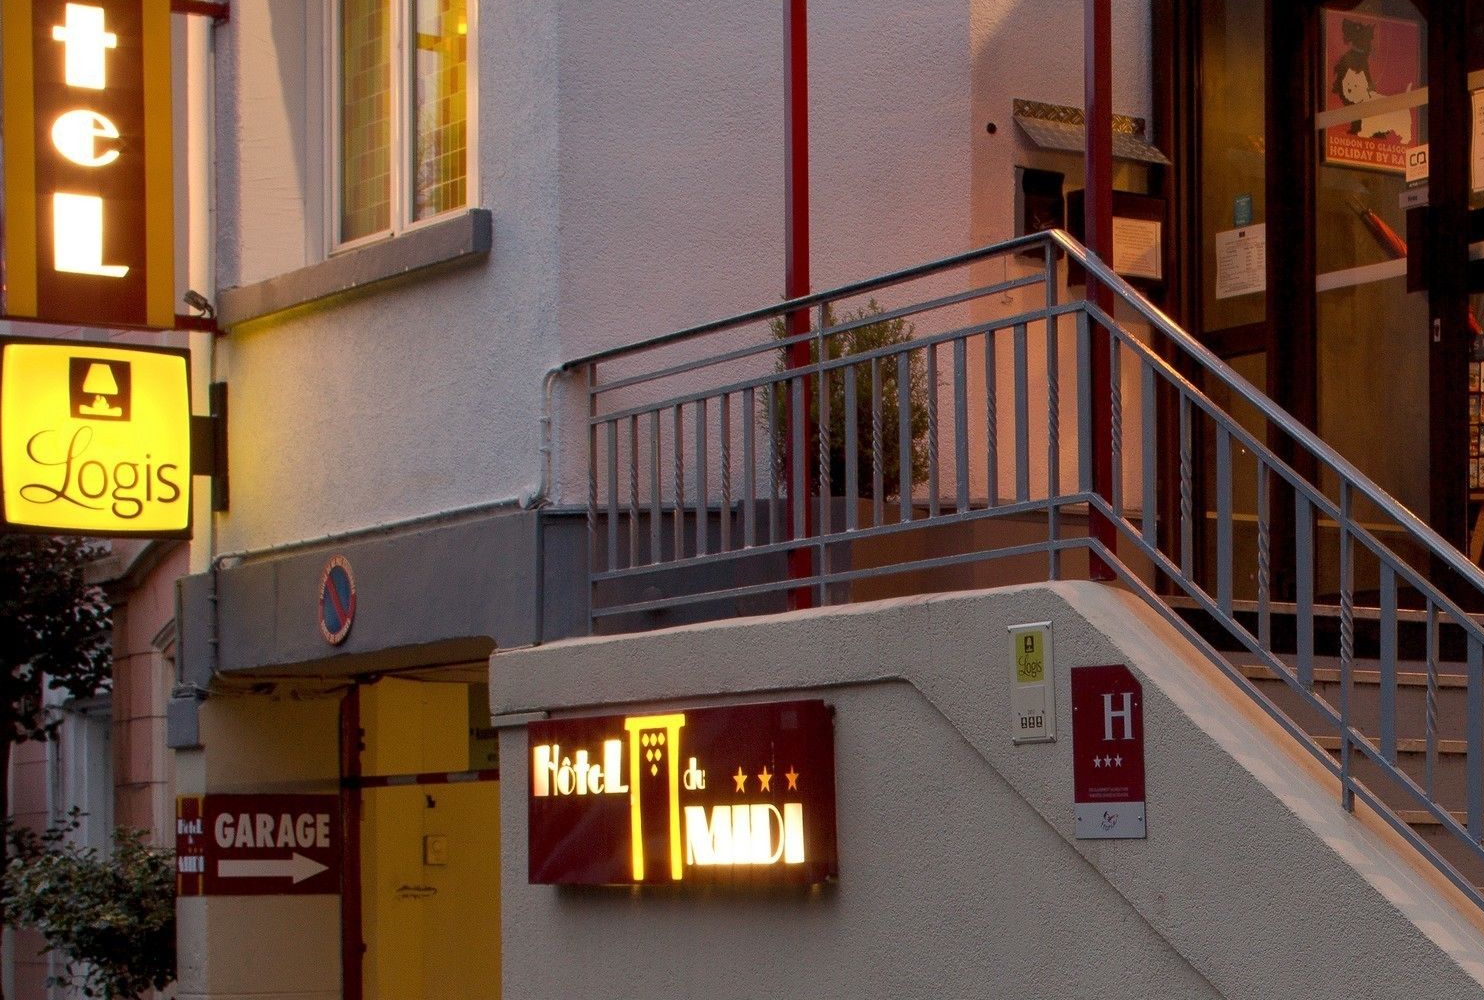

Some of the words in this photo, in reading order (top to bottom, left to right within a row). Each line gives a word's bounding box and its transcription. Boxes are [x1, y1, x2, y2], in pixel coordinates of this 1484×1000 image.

[1329, 136, 1362, 149] LONDON
[1365, 141, 1375, 150] TO
[1377, 143, 1406, 154] GLASGO
[1329, 146, 1373, 161] HOLIDAY
[1376, 151, 1388, 163] BY
[1391, 154, 1405, 166] RA
[20, 426, 181, 519] Logis
[1018, 654, 1043, 678] Logis
[1101, 692, 1135, 741] H
[683, 757, 706, 790] du
[214, 813, 331, 849] GARAGE
[684, 803, 805, 866] MIDI
